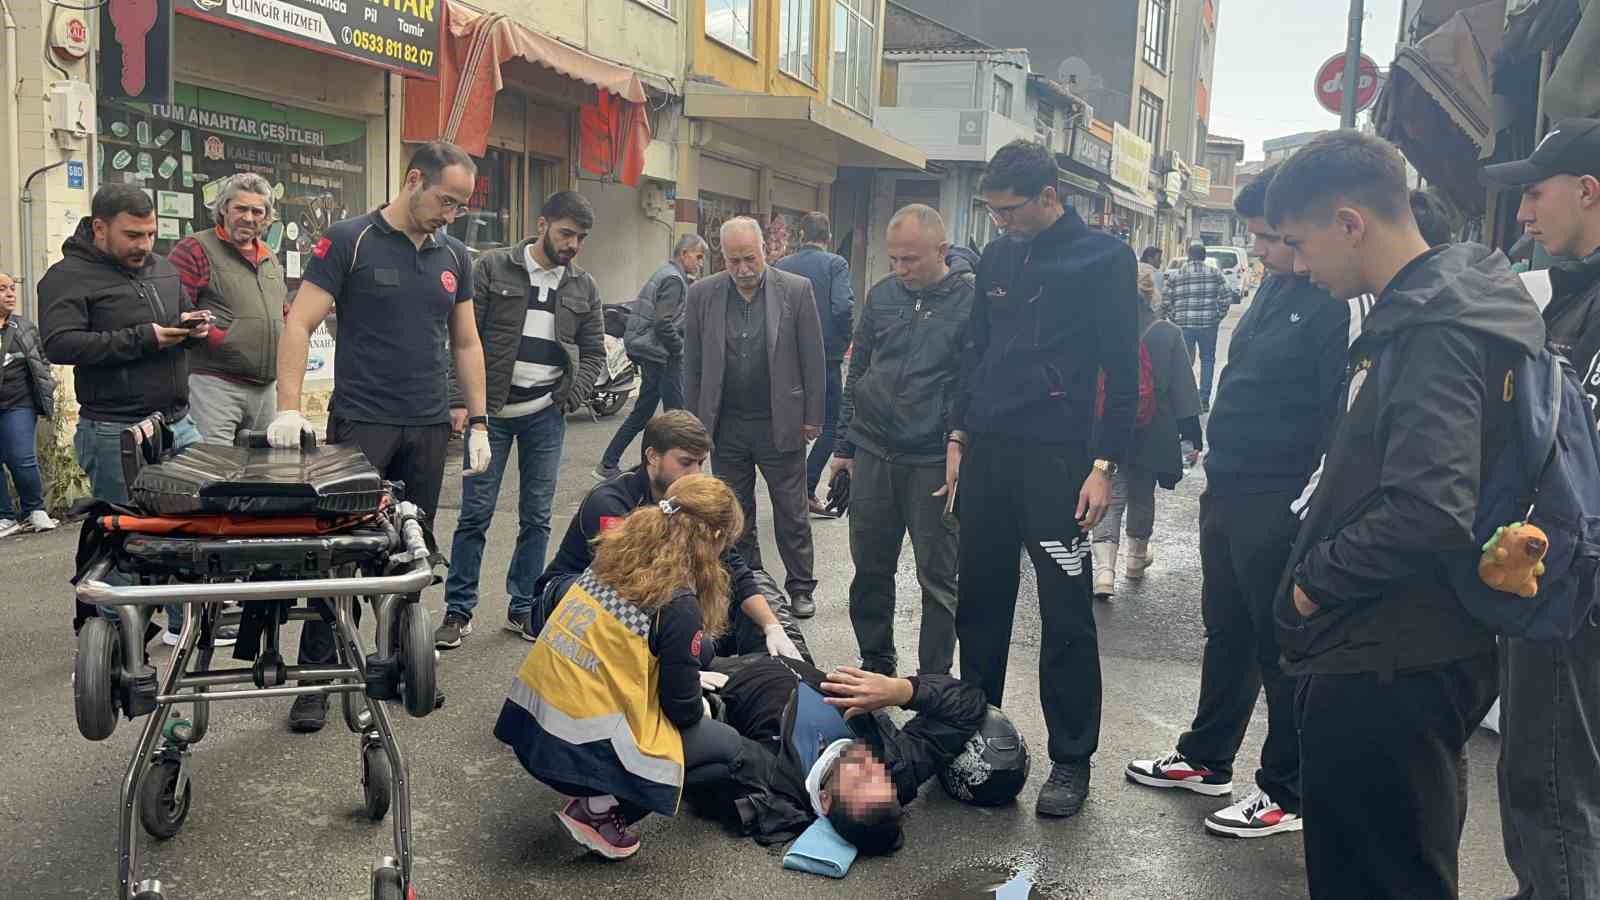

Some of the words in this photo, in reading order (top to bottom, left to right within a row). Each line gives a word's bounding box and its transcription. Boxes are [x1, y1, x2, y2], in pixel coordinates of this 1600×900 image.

[364, 7, 378, 23] Pil
[397, 17, 425, 37] Tamir
[353, 29, 384, 54] 0533
[386, 38, 402, 59] 811
[404, 44, 418, 64] 82
[419, 48, 433, 68] 07
[189, 109, 257, 135] ANAHTAR
[259, 120, 325, 146] ÇEŞİTLERİ
[559, 598, 597, 638] 112
